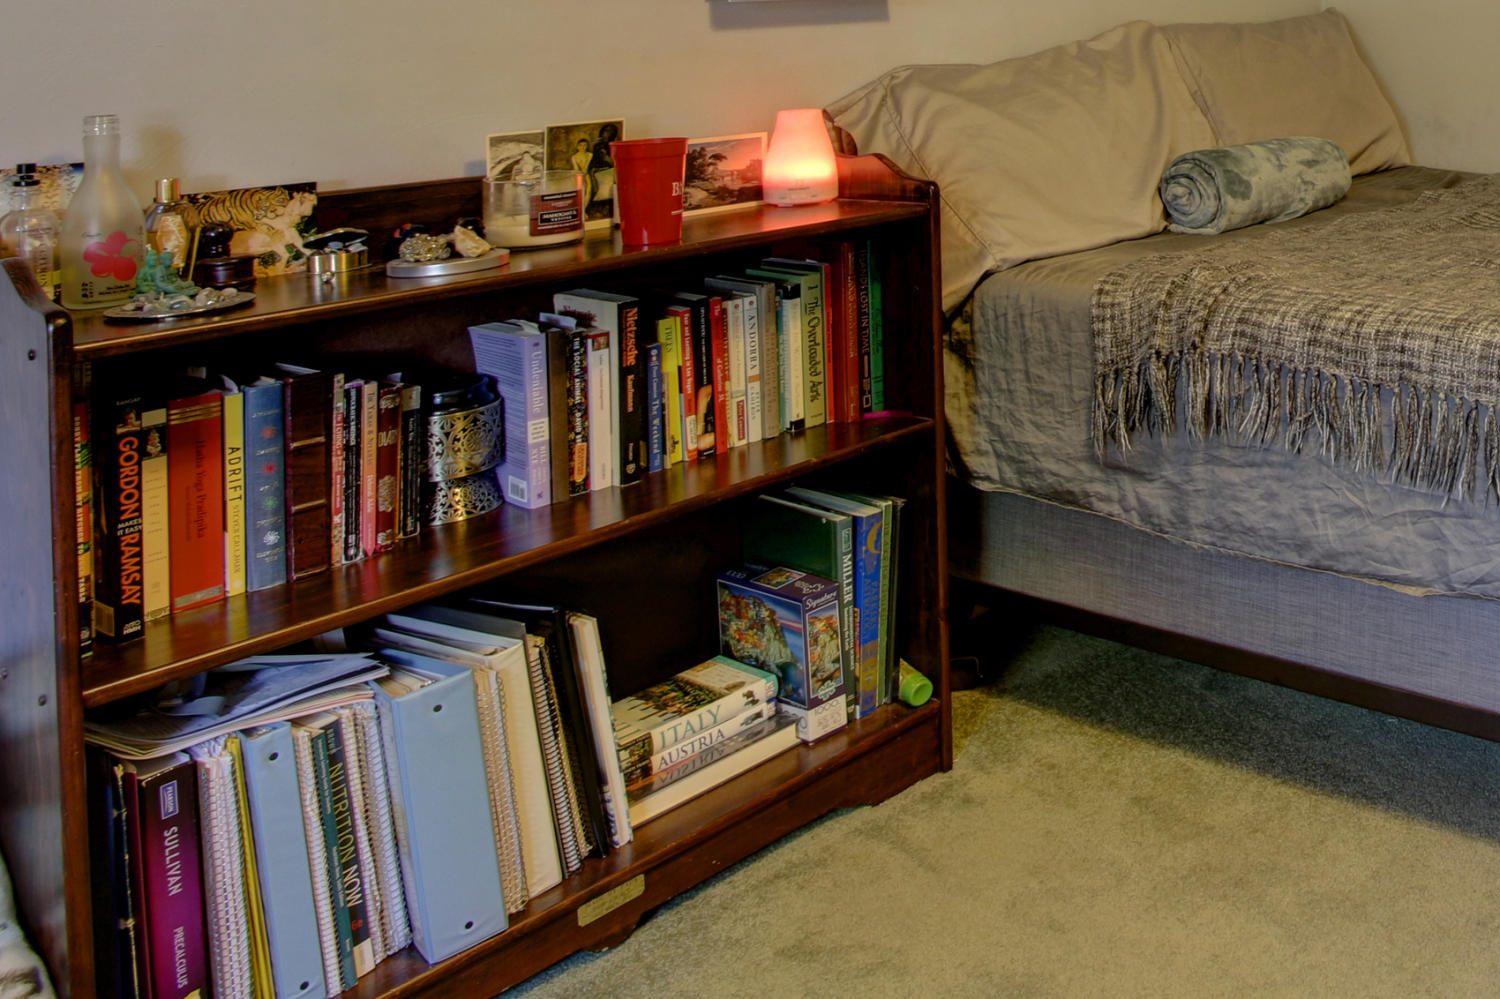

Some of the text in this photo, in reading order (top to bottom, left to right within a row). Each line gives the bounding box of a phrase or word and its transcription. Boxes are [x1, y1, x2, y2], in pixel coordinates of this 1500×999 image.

[806, 298, 820, 316] The
[860, 315, 868, 327] IN
[572, 337, 581, 350] THE
[625, 306, 639, 367] Nietzsche
[748, 314, 758, 371] ANDORRA
[808, 317, 822, 377] Overloaded
[532, 350, 546, 413] Undeniable
[573, 352, 581, 376] SOCIAL
[574, 378, 582, 404] ANIMAL
[809, 380, 823, 403] Ark
[574, 412, 583, 433] DAVID
[652, 399, 661, 454] The Weekend
[117, 436, 141, 521] GORDON
[192, 439, 208, 540] Hatha Yoga Pradipika
[227, 446, 243, 502] ADRIFT
[76, 508, 84, 543] KITCHEN
[117, 517, 142, 529] MAKES
[124, 526, 143, 536] EASY
[78, 578, 86, 603] TABLE
[120, 533, 142, 606] RAMSAY
[841, 553, 854, 604] MILLER
[805, 590, 837, 611] Signature
[657, 728, 726, 771] AUSTRIA
[659, 704, 723, 750] ITALY
[166, 785, 176, 813] PEARSON
[330, 761, 356, 863] NUTRITION
[163, 825, 184, 897] SULLIVAN
[342, 864, 363, 909] NOW
[173, 926, 189, 991] PRECALCULUS
